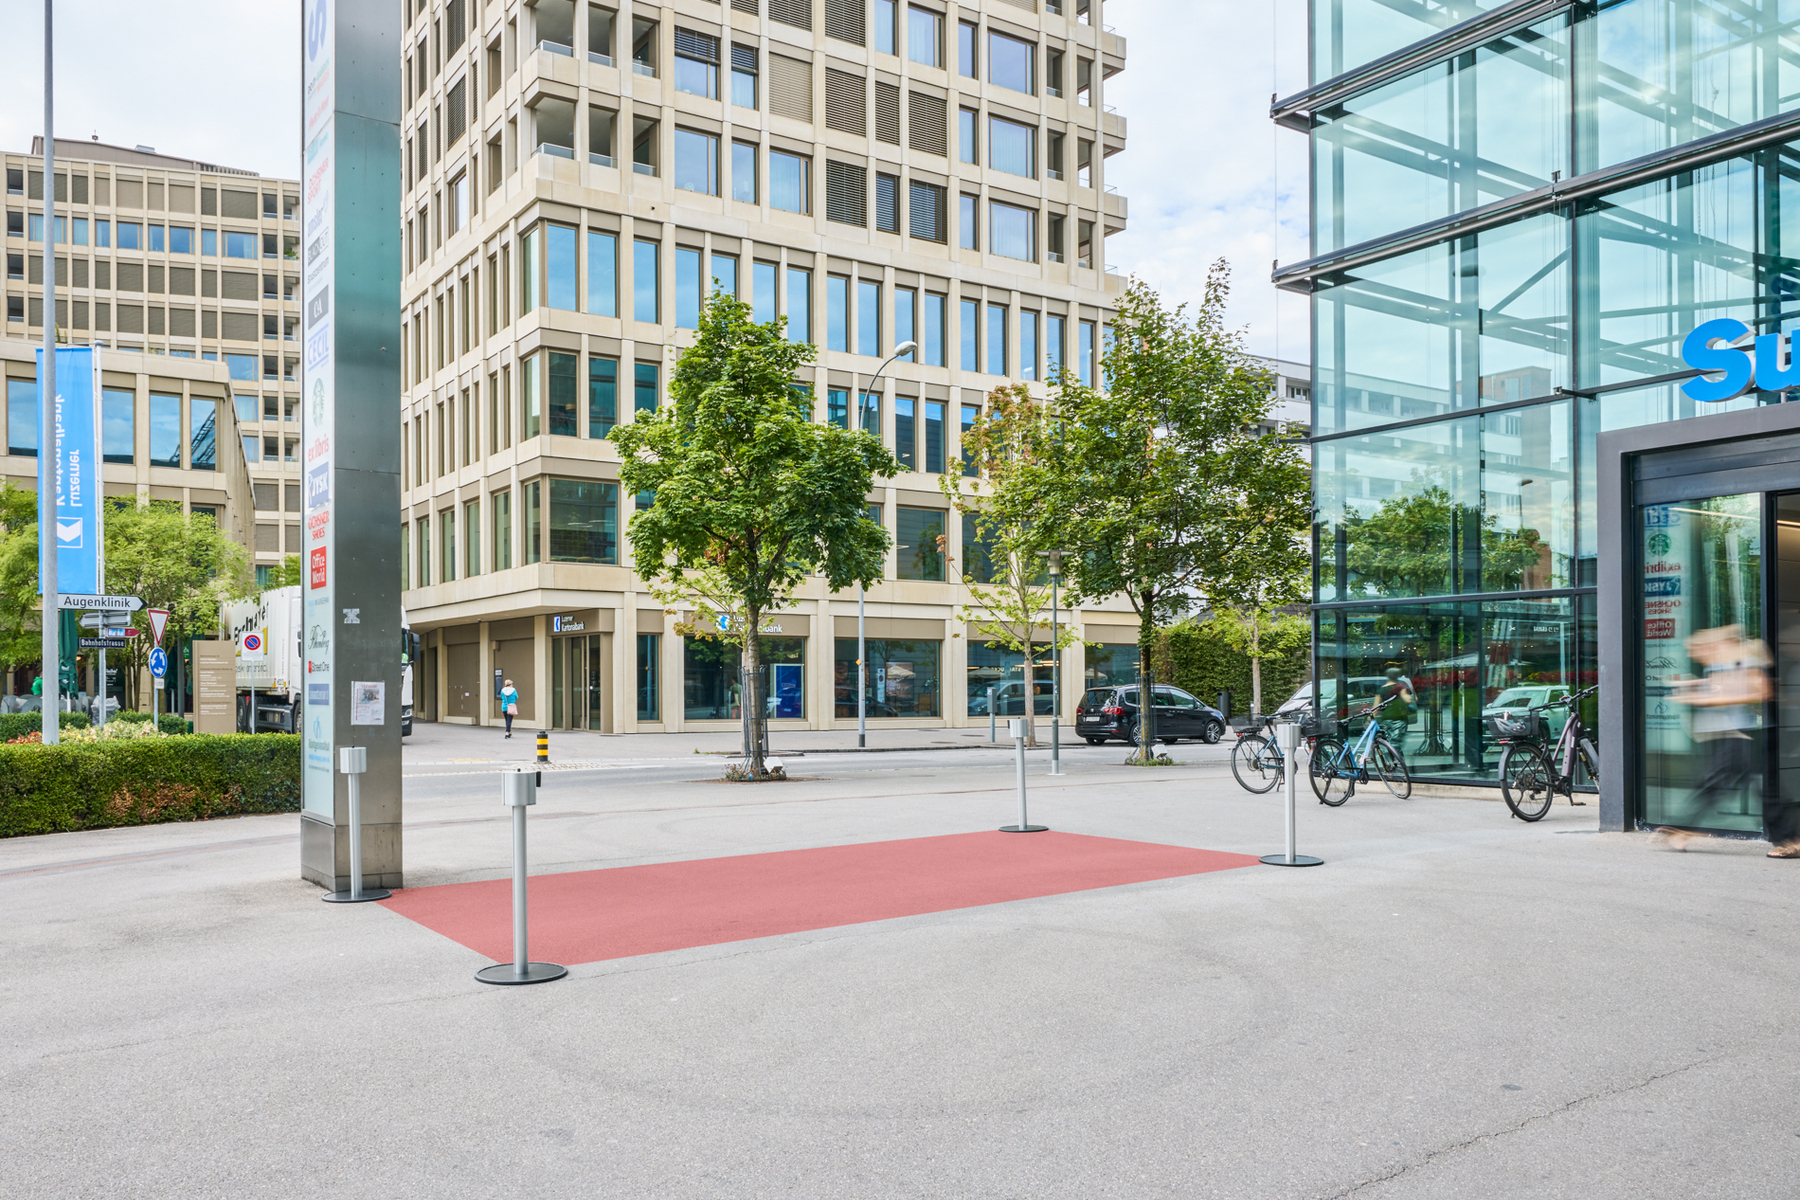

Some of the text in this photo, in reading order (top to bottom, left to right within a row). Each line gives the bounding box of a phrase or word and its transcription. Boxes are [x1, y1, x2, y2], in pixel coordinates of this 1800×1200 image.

[308, 331, 329, 366] CECIL
[1680, 318, 1800, 402] Su
[308, 510, 330, 530] OCHSNER
[312, 527, 325, 541] SHOES
[312, 553, 325, 569] Office
[312, 567, 326, 584] World
[64, 596, 131, 609] Augenklinik
[81, 639, 124, 647] Bahnhofstrasse
